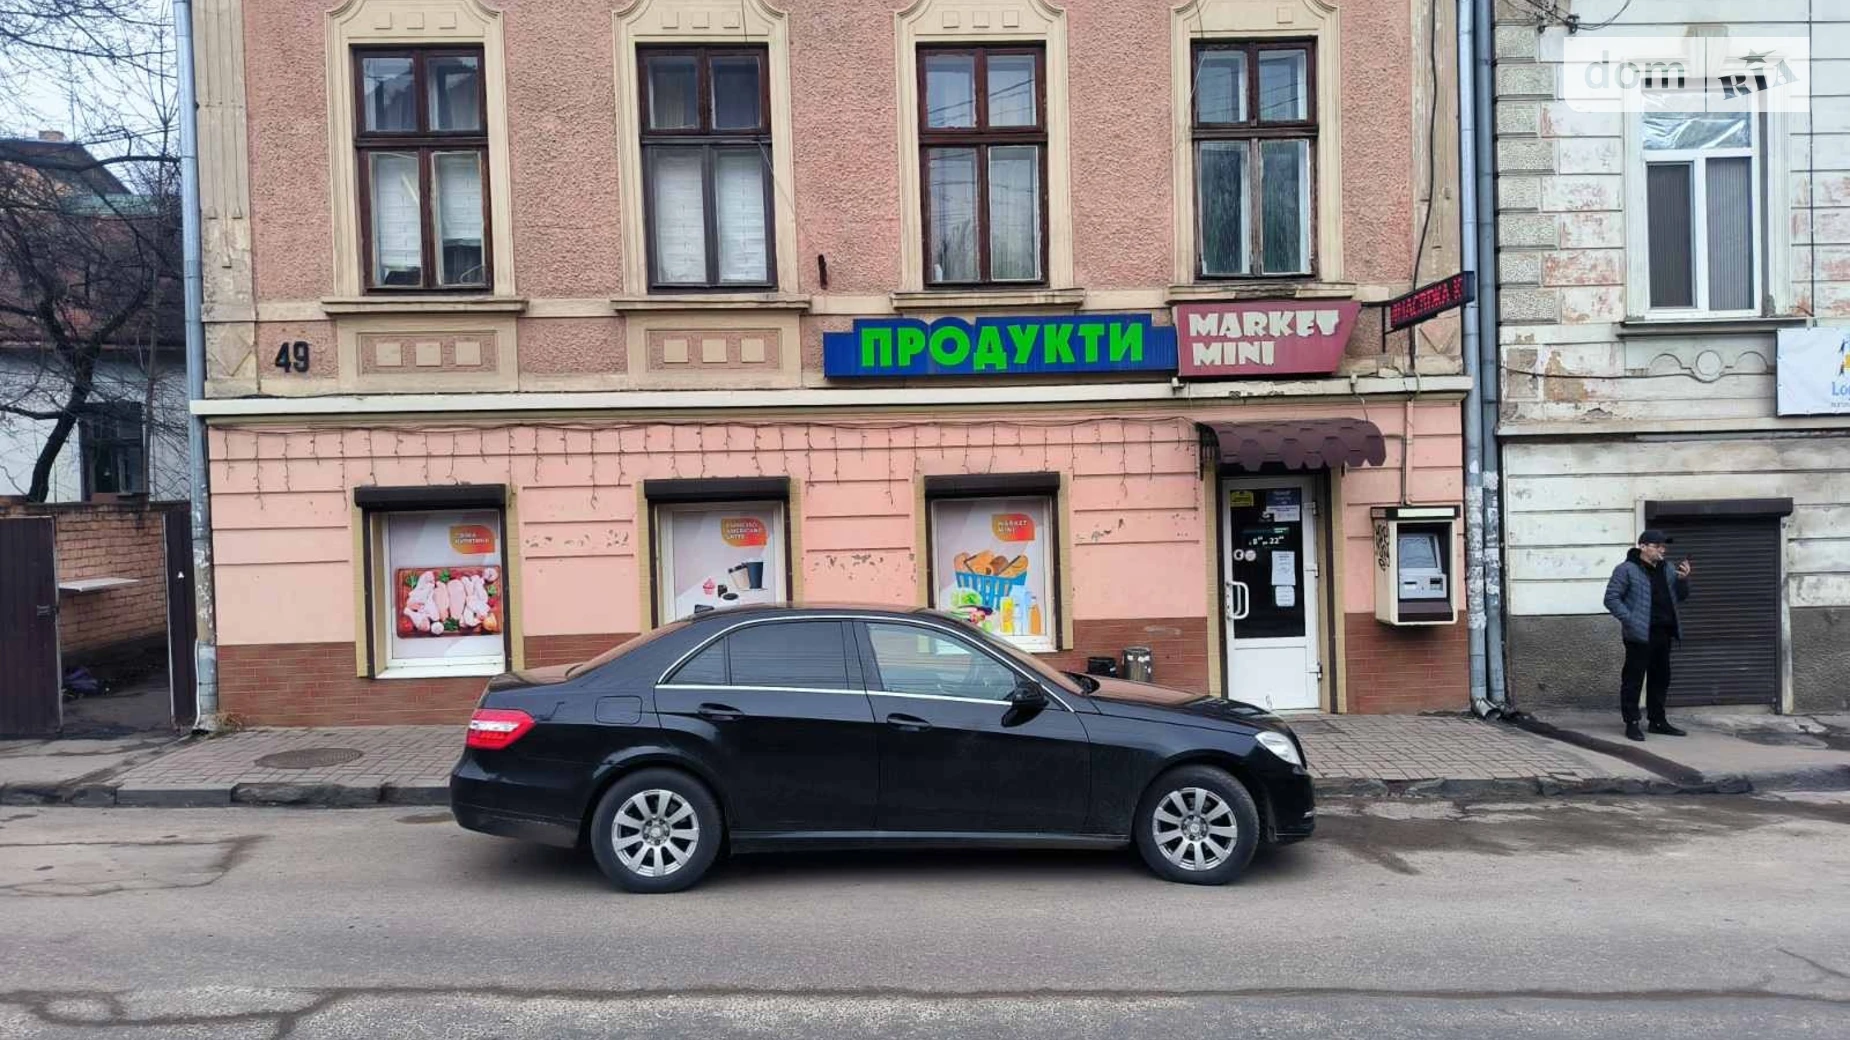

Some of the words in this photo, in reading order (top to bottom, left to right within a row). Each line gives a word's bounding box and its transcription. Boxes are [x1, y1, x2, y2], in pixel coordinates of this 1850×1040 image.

[1188, 309, 1340, 338] MARKET
[275, 340, 310, 374] 49
[861, 322, 1144, 370] ПРОДУКТИ
[1192, 341, 1276, 367] MINI
